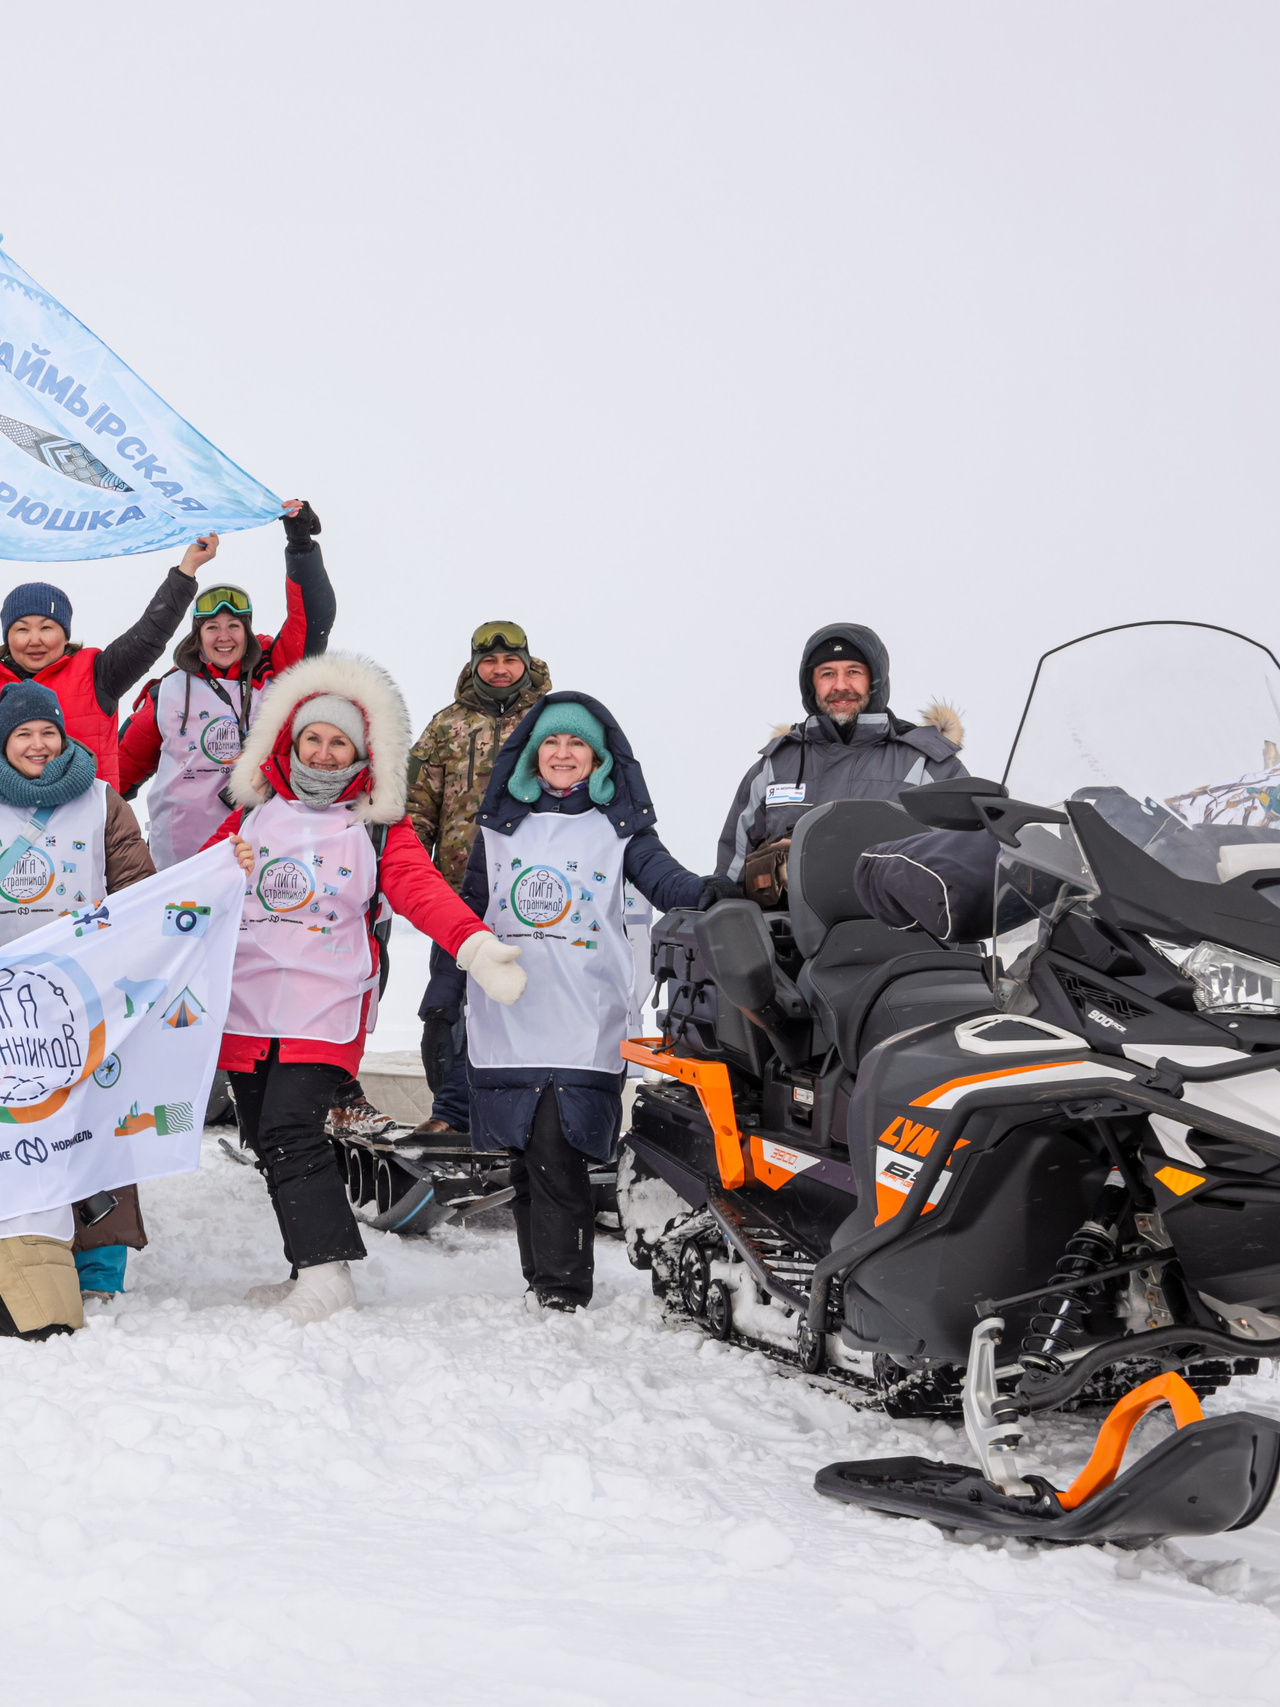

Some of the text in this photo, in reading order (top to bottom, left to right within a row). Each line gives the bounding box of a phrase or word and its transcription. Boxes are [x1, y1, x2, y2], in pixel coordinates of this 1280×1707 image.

[217, 727, 236, 741] ЛИГА
[274, 873, 298, 889] ЛИГА
[529, 881, 553, 899] ЛИГА
[770, 1147, 799, 1166] 3900
